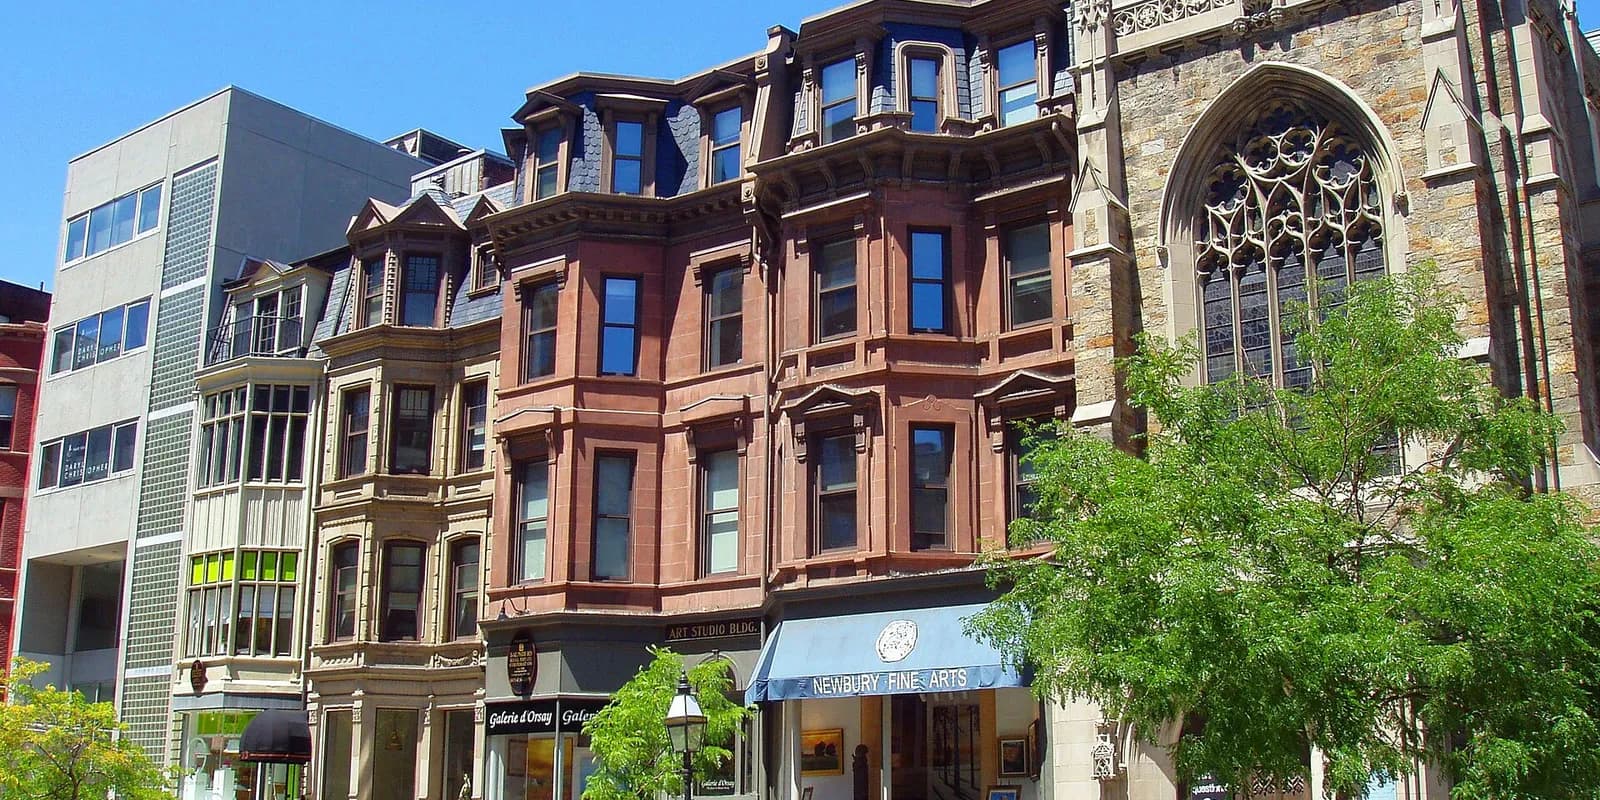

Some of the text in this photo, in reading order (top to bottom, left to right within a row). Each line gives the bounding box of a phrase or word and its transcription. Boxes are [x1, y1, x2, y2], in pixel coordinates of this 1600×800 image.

[669, 622, 757, 639] ART STUDIO BLDG.
[813, 669, 967, 694] NEWBURY FINE ARTS
[490, 710, 552, 728] Galerie d'Orsay
